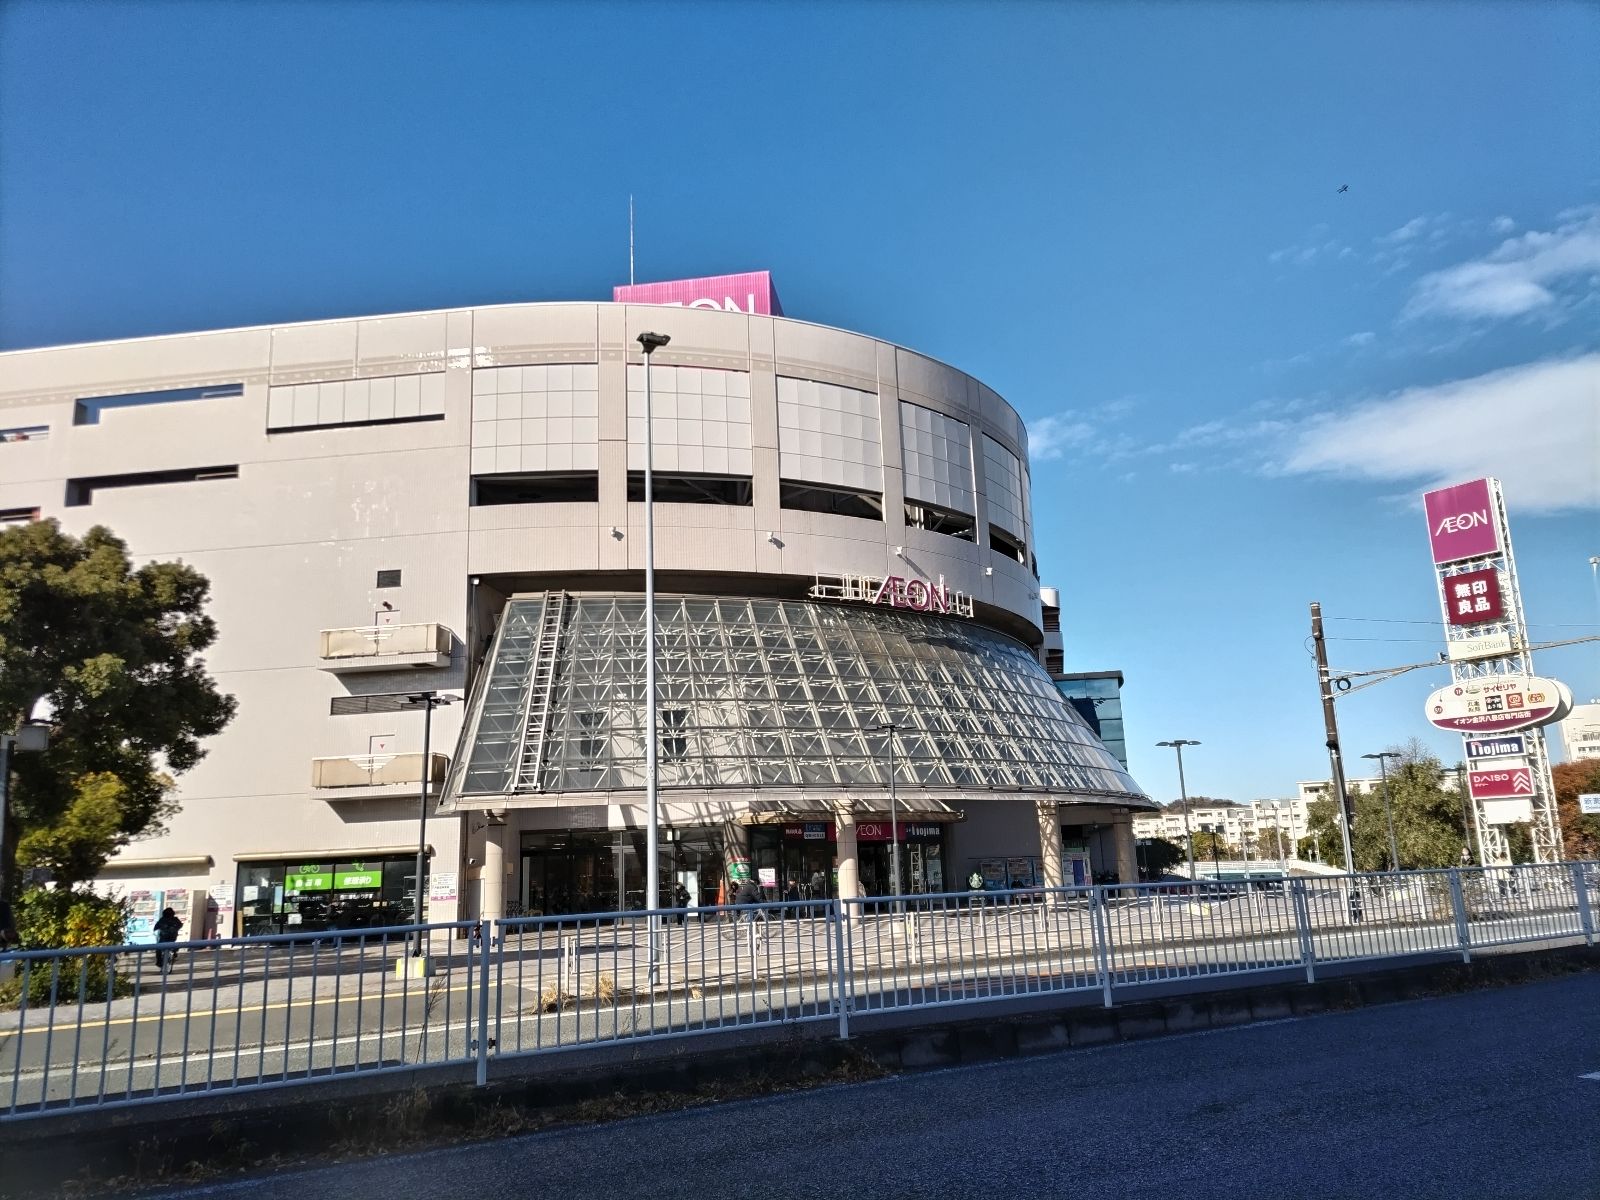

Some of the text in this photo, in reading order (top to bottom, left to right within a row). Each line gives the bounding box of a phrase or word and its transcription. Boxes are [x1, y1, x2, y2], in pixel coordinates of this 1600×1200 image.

[1454, 580, 1488, 598] 無印
[1458, 598, 1491, 615] 良品
[1467, 640, 1507, 653] SoftBank
[1473, 773, 1510, 783] DAISO
